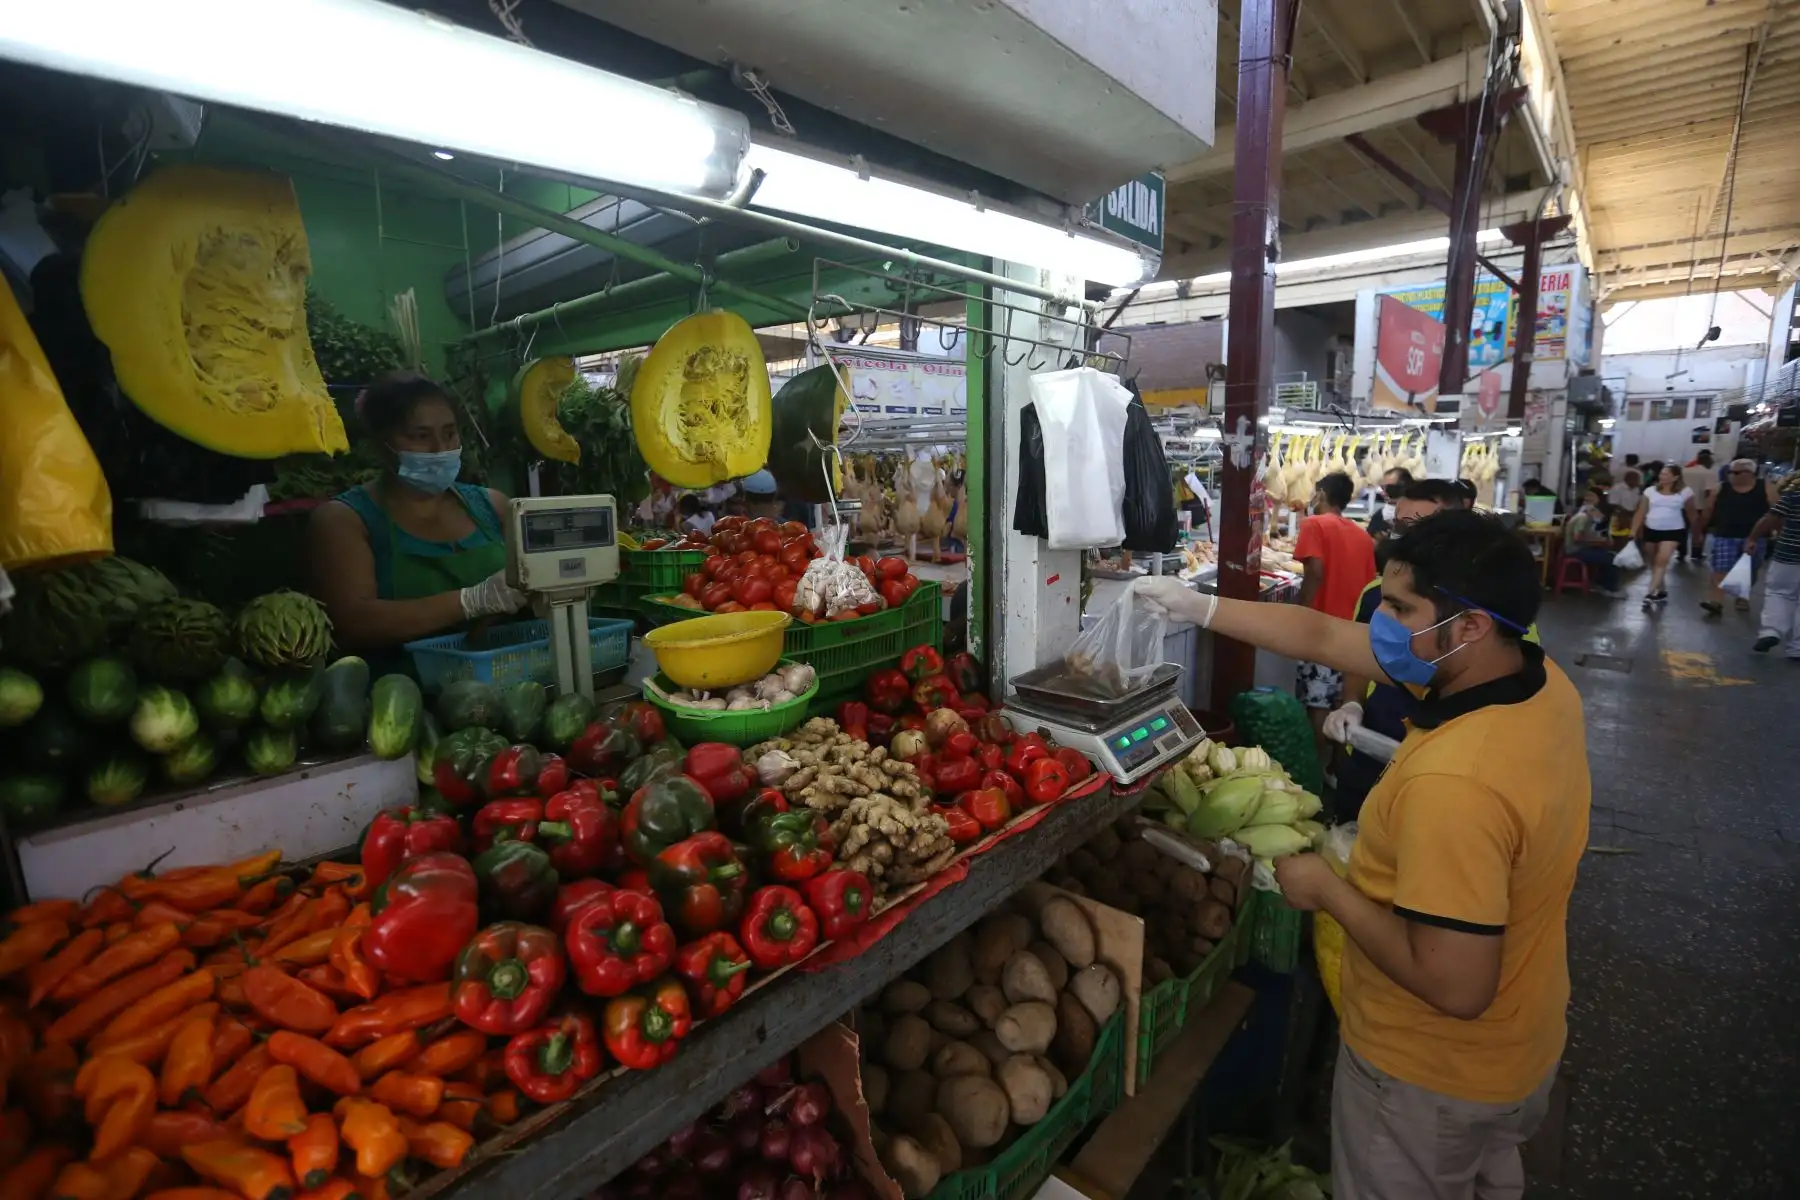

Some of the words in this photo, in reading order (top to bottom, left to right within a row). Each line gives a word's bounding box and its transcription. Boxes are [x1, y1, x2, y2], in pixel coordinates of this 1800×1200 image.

[1107, 180, 1158, 236] SALIDA
[1540, 272, 1571, 293] ERIA
[923, 362, 965, 377] Olin
